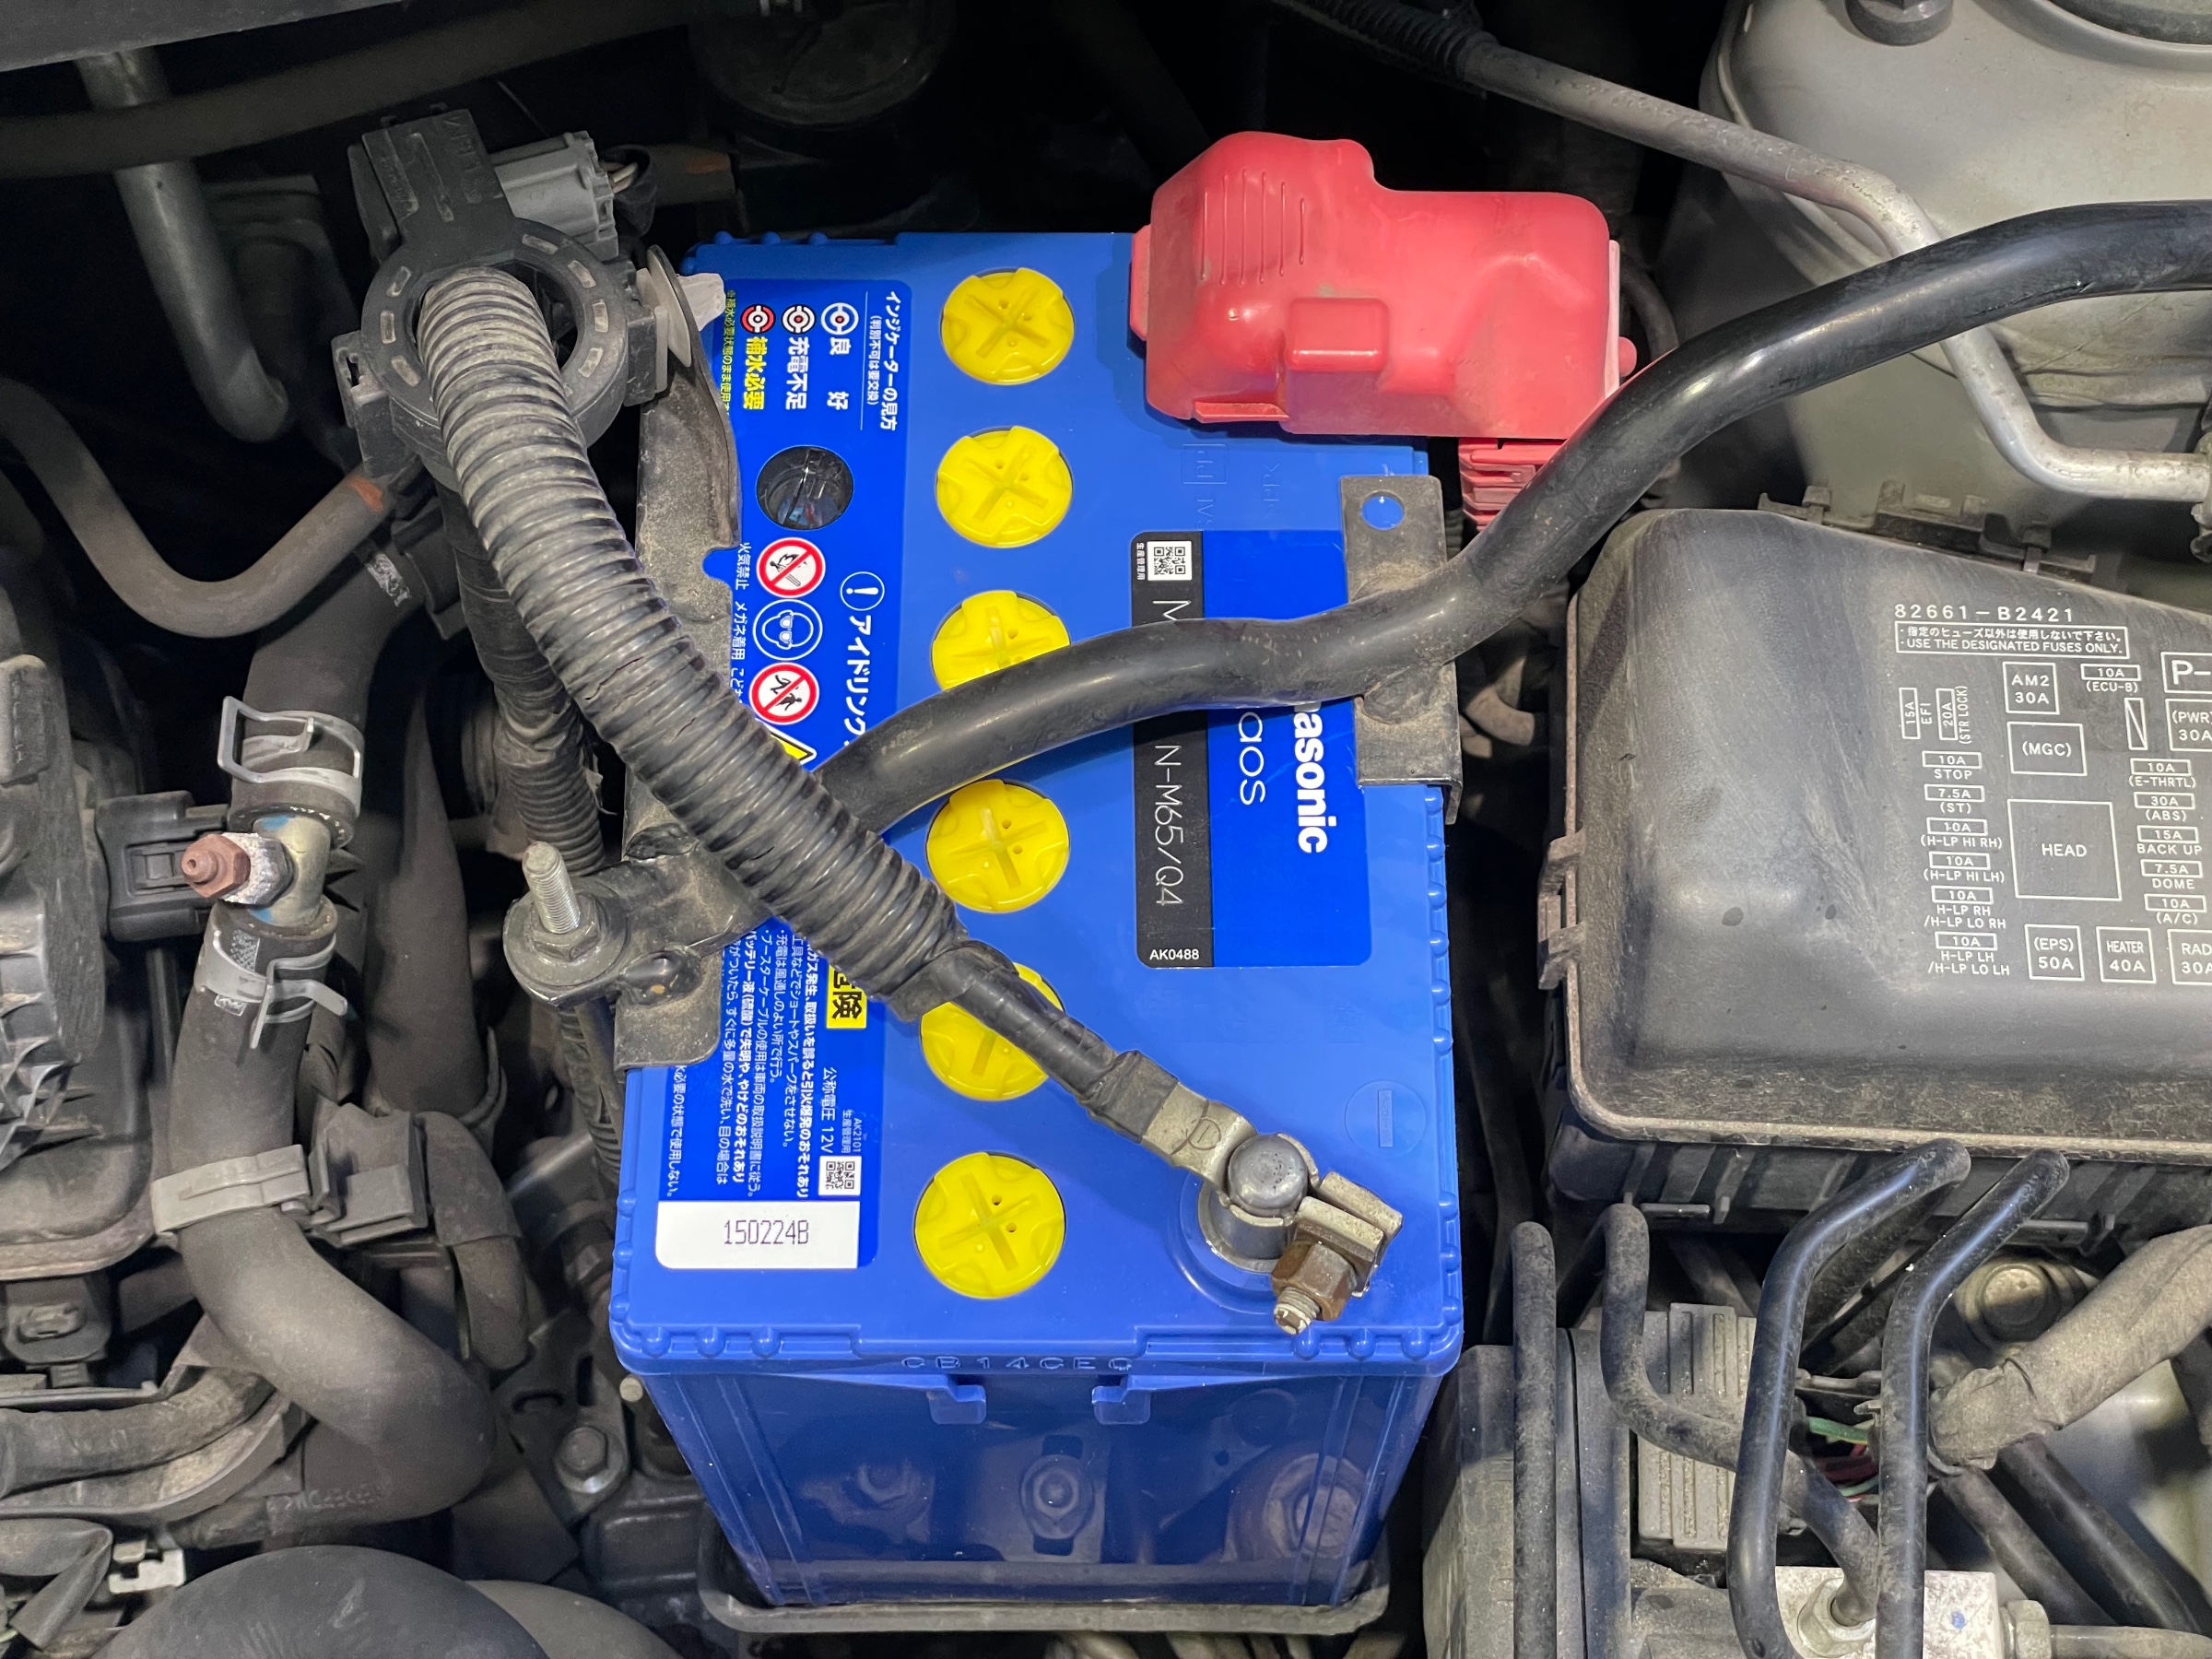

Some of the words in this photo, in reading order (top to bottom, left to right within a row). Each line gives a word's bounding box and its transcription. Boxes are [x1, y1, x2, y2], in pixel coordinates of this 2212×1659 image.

[829, 337, 851, 355] 良
[720, 290, 736, 418] ※補水必要状態のまま使用
[866, 315, 882, 406] (判別不可は要交換)
[880, 290, 901, 430] インジケーターの見方
[743, 336, 769, 409] 補水必要
[785, 336, 810, 410] 充電不足
[827, 392, 849, 410] 好
[735, 542, 752, 591] 火気禁止
[1135, 542, 1146, 580] 生産管理用
[1894, 604, 2073, 623] 82661-B2421
[731, 601, 747, 660] メガネ着用
[1936, 640, 1960, 650] THE
[1962, 640, 2041, 652] DESIGNATED
[2042, 641, 2082, 653] FUSES
[2085, 642, 2123, 653] ONLY.
[2097, 667, 2124, 678] 10A
[2011, 674, 2050, 687] AM2
[2086, 680, 2138, 693] (ECU-B)
[1954, 686, 1970, 717] LOCK)
[2015, 692, 2050, 704] 30A
[1904, 701, 1916, 724] 15A
[1920, 702, 1933, 724] EFI
[1941, 702, 1954, 728] 20A
[1958, 721, 1972, 745] (STR
[2178, 729, 2212, 742] 30A
[2022, 741, 2073, 757] (MGC)
[1238, 712, 1266, 806] aos
[1938, 754, 1966, 765] 10A
[2147, 762, 2175, 772] 10A
[1934, 769, 1972, 781] STOP
[2128, 776, 2196, 788] (E-THRTL)
[1938, 788, 1971, 799] 7.5A
[2151, 796, 2178, 806] 30A
[1939, 802, 1971, 815] (ST)
[2146, 809, 2187, 822] (ABS)
[1155, 745, 1184, 907] N-M65/Q4
[1944, 822, 1971, 832] 10A
[2154, 830, 2183, 841] 15A
[1920, 836, 1959, 848] (H-LP
[1962, 837, 1979, 848] HI
[1982, 837, 2003, 849] RH)
[2136, 843, 2179, 855] BACK
[2183, 845, 2203, 855] UP
[2041, 843, 2088, 857] HEAD
[1947, 856, 1974, 867] 10A
[2154, 864, 2189, 875] 7.5A
[1924, 870, 1961, 882] (H-LP
[1966, 872, 1980, 882] HI
[1983, 871, 2005, 883] LH)
[2152, 878, 2195, 889] DOME
[1948, 890, 1977, 901] 10A
[1936, 905, 1969, 916] H-LP
[1972, 906, 1991, 916] RH
[2161, 899, 2190, 910] 10A
[1924, 915, 1963, 927] /H-LP
[1967, 917, 1984, 928] LO
[1989, 918, 2006, 929] RH
[2157, 912, 2198, 924] (A/C)
[1952, 936, 1981, 947] 10A
[2034, 936, 2074, 952] (EPS)
[2106, 940, 2144, 954] HEATER
[1149, 947, 1200, 960] AK0488
[1941, 951, 1972, 962] H-LP
[1977, 952, 1994, 962] LH
[1928, 961, 1967, 973] /H-LP
[1971, 963, 1988, 974] LO
[1993, 964, 2010, 976] LH
[2038, 957, 2074, 971] 50A
[2110, 959, 2146, 972] 40A
[2181, 960, 2212, 974] 30A
[821, 1066, 837, 1121] 公称電圧
[841, 1110, 853, 1153] 生産管理用
[853, 1118, 862, 1153] AK2101
[820, 1126, 834, 1154] 12V
